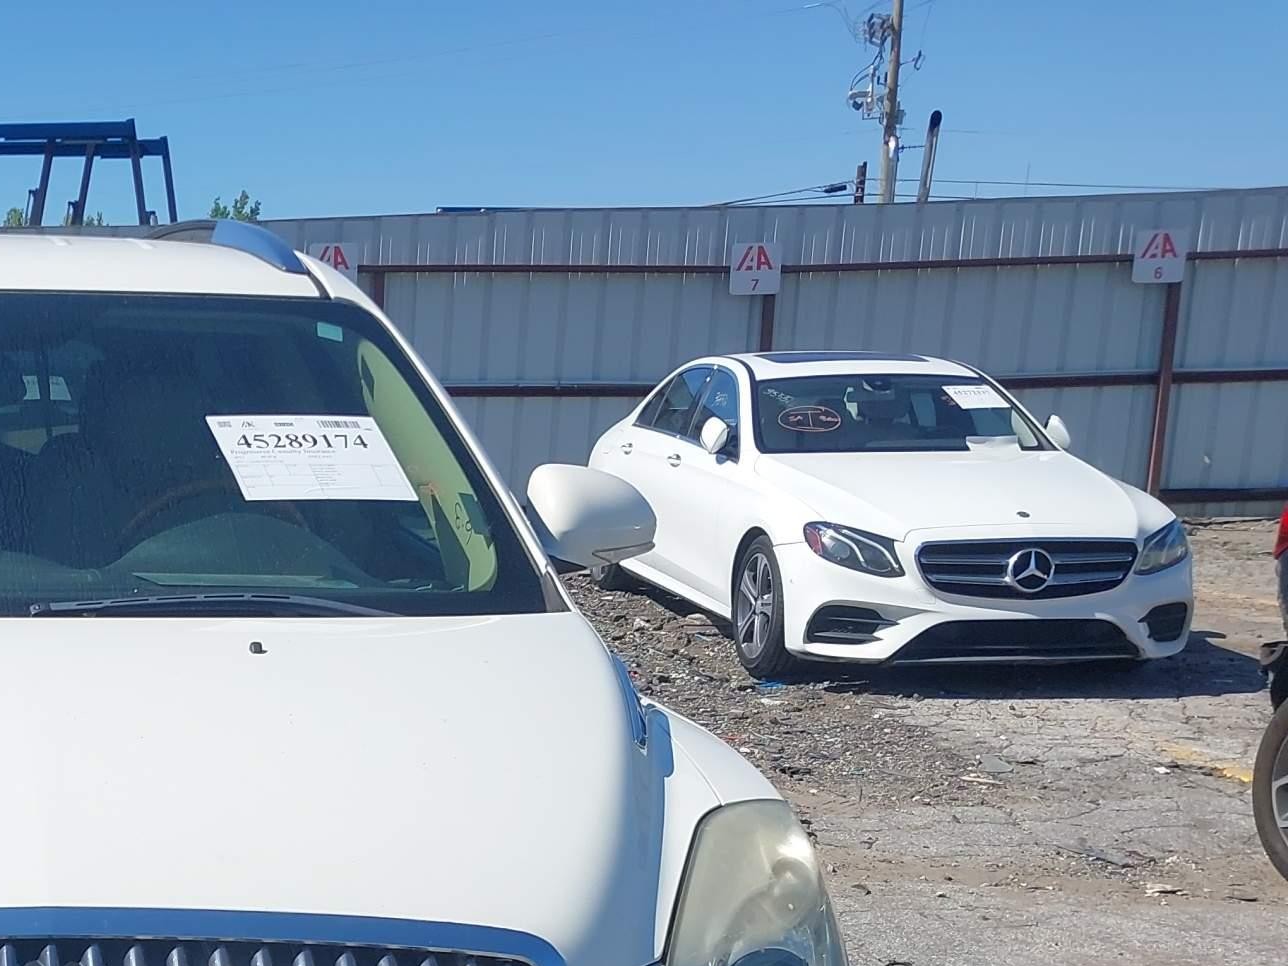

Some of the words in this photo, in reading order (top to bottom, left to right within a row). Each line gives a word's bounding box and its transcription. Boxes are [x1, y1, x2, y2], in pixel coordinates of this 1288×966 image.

[1154, 266, 1162, 279] 6
[751, 279, 760, 291] 7
[237, 434, 368, 449] 45289174
